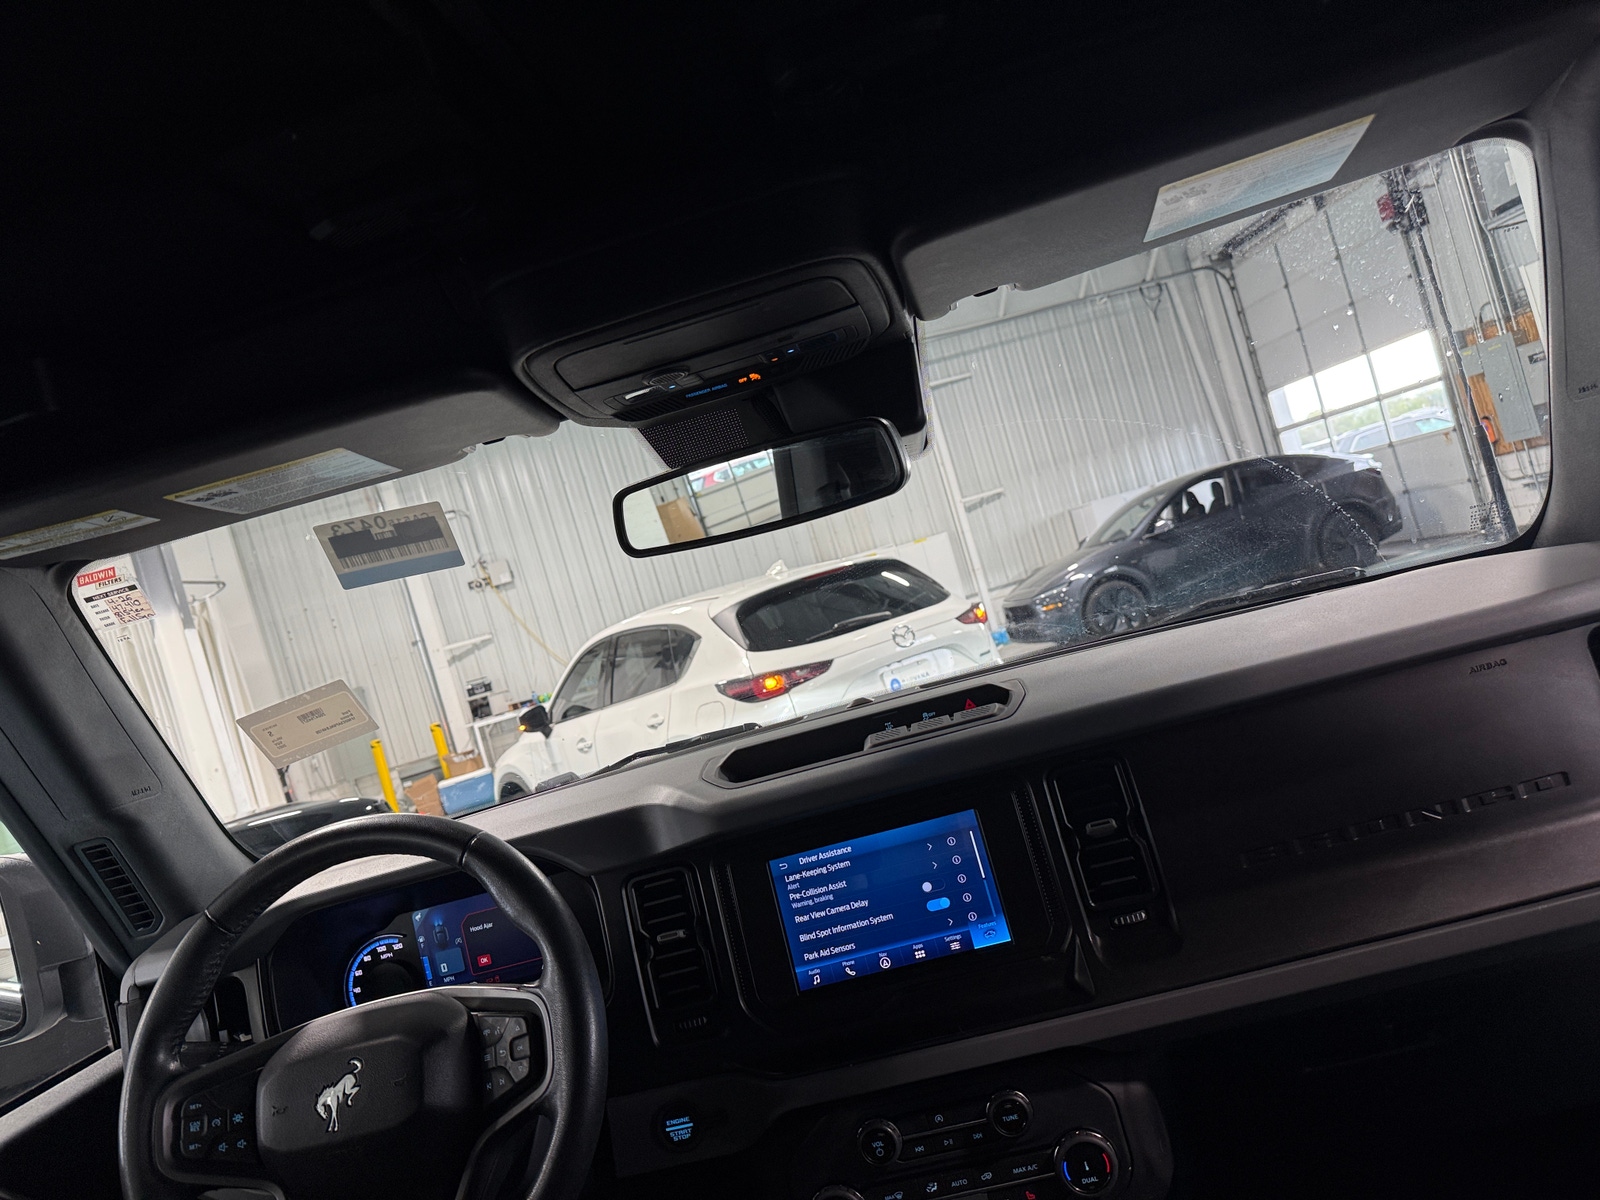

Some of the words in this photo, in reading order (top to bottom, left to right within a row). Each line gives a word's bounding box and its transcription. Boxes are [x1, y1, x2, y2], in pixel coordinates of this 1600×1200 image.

[712, 383, 728, 391] AIRBAG
[80, 568, 115, 586] BALDWIN
[98, 577, 122, 588] FILTERS
[92, 593, 107, 601] NEXT
[107, 587, 130, 597] SERVICE
[1468, 658, 1508, 675] AIRBAG
[799, 854, 818, 865] Driver
[818, 846, 852, 860] Assistance
[784, 866, 828, 883] Lane-Keeping
[827, 860, 851, 872] System
[787, 882, 800, 891] Alert
[789, 885, 828, 901] Pre-Collision
[828, 880, 847, 891] Assist
[814, 893, 834, 904] braking
[794, 914, 810, 924] Rear
[810, 910, 826, 920] View
[826, 904, 851, 915] Camera
[850, 899, 869, 910] Delay
[469, 923, 483, 933] Hood
[482, 921, 493, 931] Ajar
[799, 931, 817, 942] Blind
[816, 928, 832, 939] Spot
[832, 919, 870, 934] Information
[869, 913, 894, 925] System
[978, 920, 997, 929] Features
[944, 934, 962, 942] Settings
[376, 945, 387, 953] 100
[803, 952, 820, 961] Park
[819, 948, 831, 957] Aid
[830, 942, 856, 954] Sensors
[380, 952, 394, 960] MPH
[443, 975, 456, 983] MPH
[666, 1116, 691, 1126] ENGINE
[1002, 1113, 1019, 1122] TUNE
[670, 1128, 692, 1138] START
[673, 1134, 691, 1142] STOP
[871, 1140, 885, 1148] VOL
[1012, 1164, 1026, 1174] MAX
[1026, 1163, 1039, 1172] A/C
[951, 1178, 968, 1188] AUTO
[1081, 1175, 1099, 1185] DUAL
